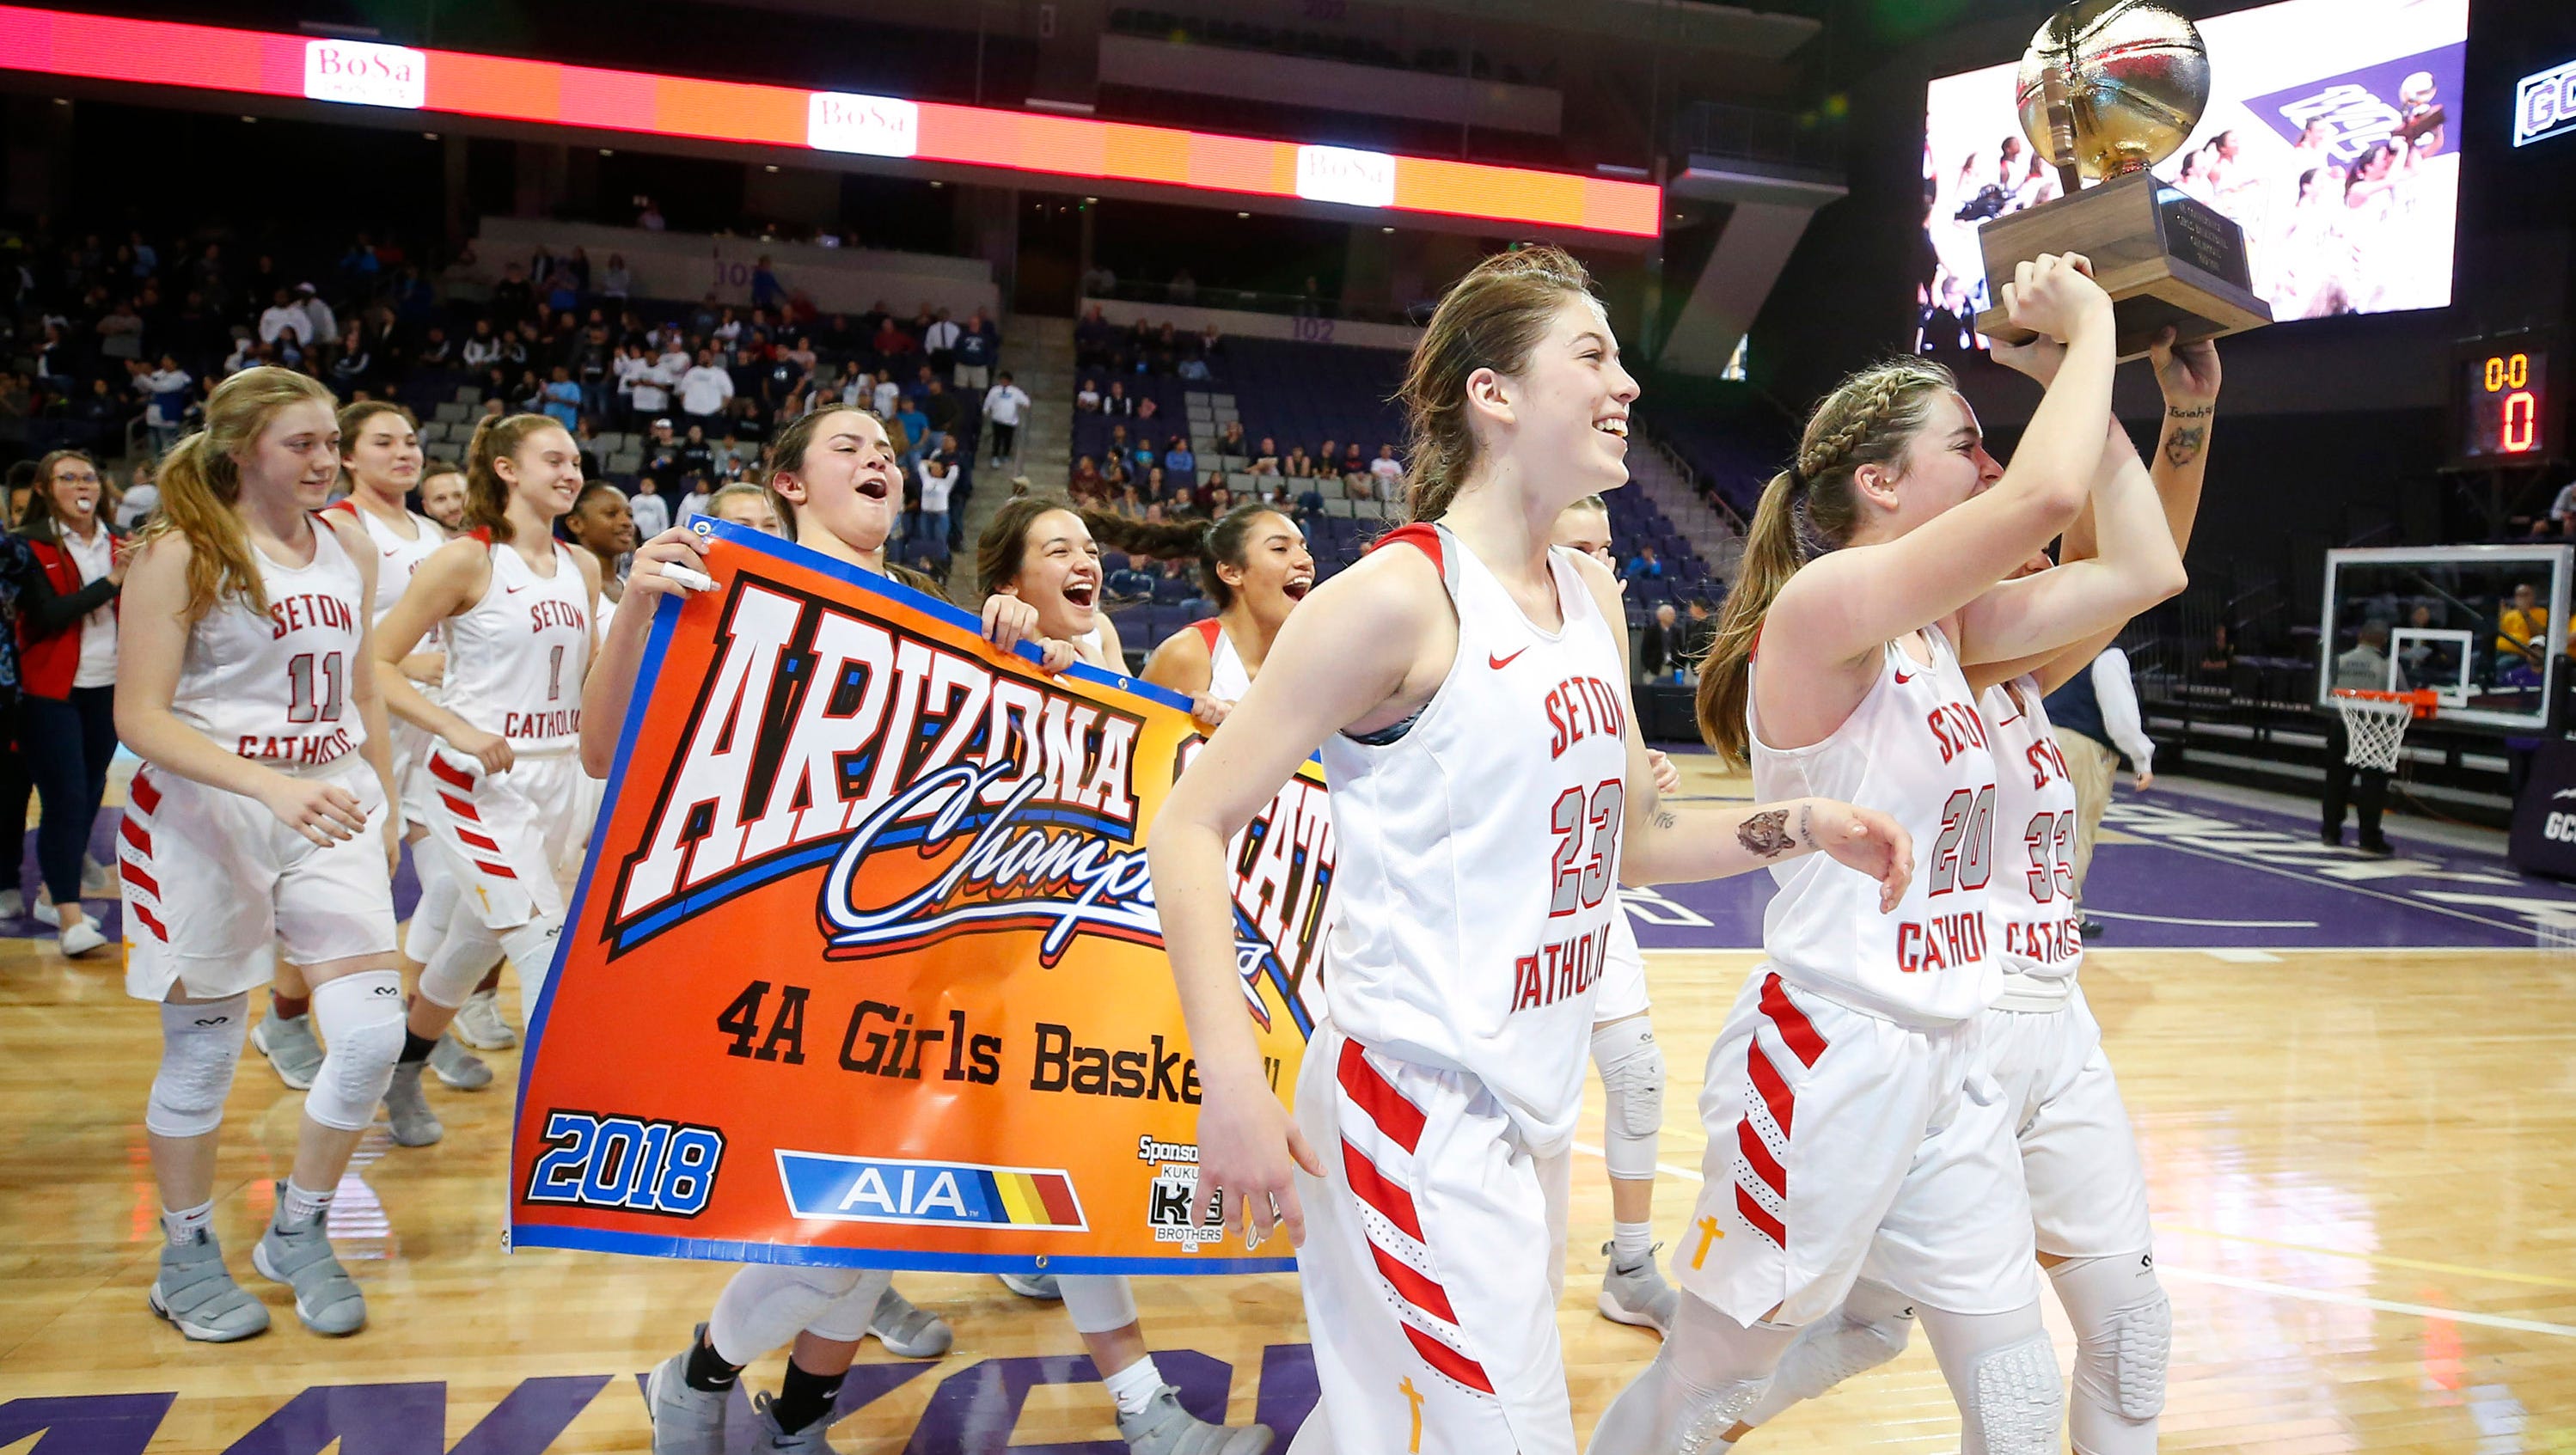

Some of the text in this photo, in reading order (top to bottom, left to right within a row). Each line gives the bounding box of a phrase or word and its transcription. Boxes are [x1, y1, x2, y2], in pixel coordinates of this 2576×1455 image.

[318, 47, 411, 82] BoSa
[716, 260, 755, 287] 10
[1293, 316, 1335, 344] 102
[2503, 391, 2535, 452] 0
[270, 594, 352, 640] SETON
[530, 599, 585, 633] SETON
[287, 651, 342, 724] 11
[548, 645, 565, 701] 1
[612, 581, 1143, 923] ARIZONA
[1549, 779, 1623, 918] 23
[1929, 784, 1995, 899] 20
[2543, 810, 2576, 844] GC
[2023, 810, 2075, 904] 33
[717, 981, 811, 1066] 4A
[838, 1000, 1002, 1086] Girls
[526, 1110, 724, 1217] 2018
[1139, 1135, 1200, 1166] Sponso
[837, 1166, 968, 1217] AIA
[1157, 1227, 1222, 1241] BROTHERS
